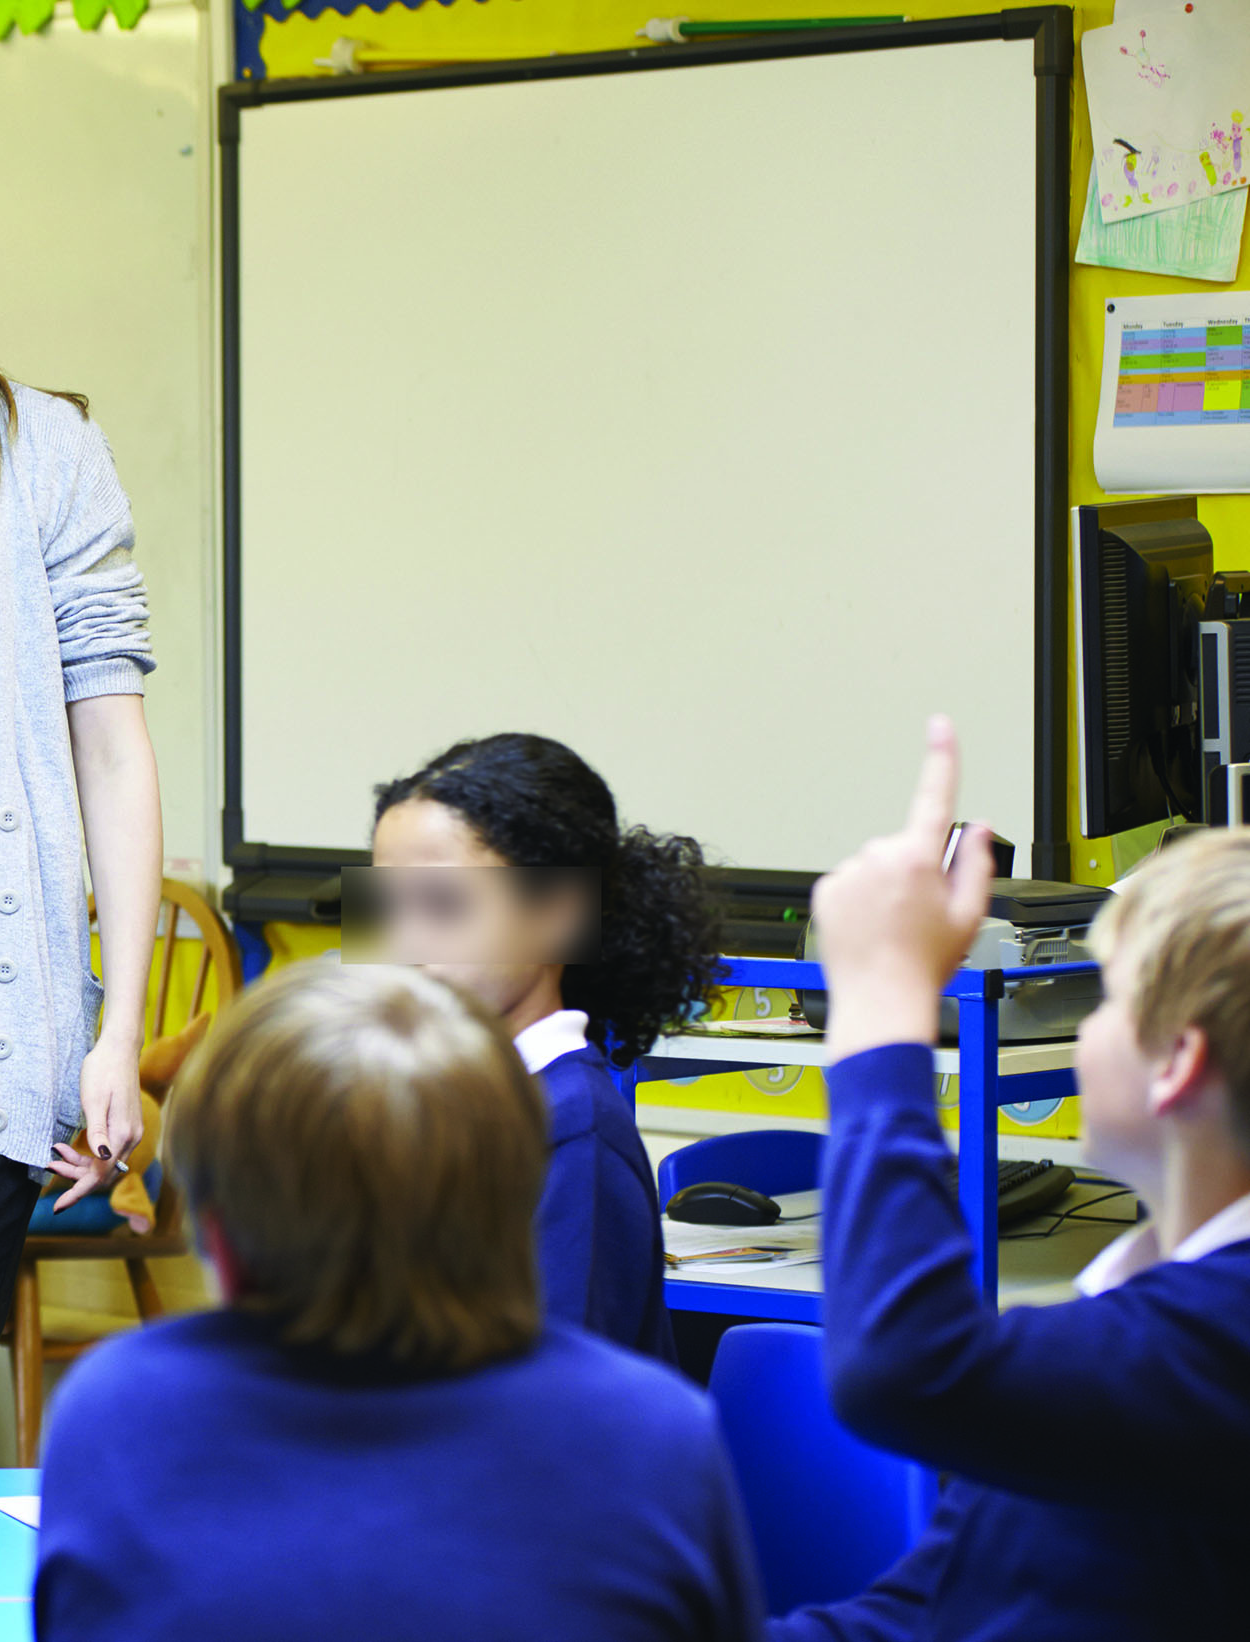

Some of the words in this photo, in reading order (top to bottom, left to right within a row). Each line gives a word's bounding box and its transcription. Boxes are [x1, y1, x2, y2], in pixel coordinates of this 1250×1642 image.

[1123, 322, 1143, 330] Monday
[1163, 321, 1184, 329] Tuesday
[1207, 318, 1238, 326] Wednesday
[754, 987, 771, 1017] 5
